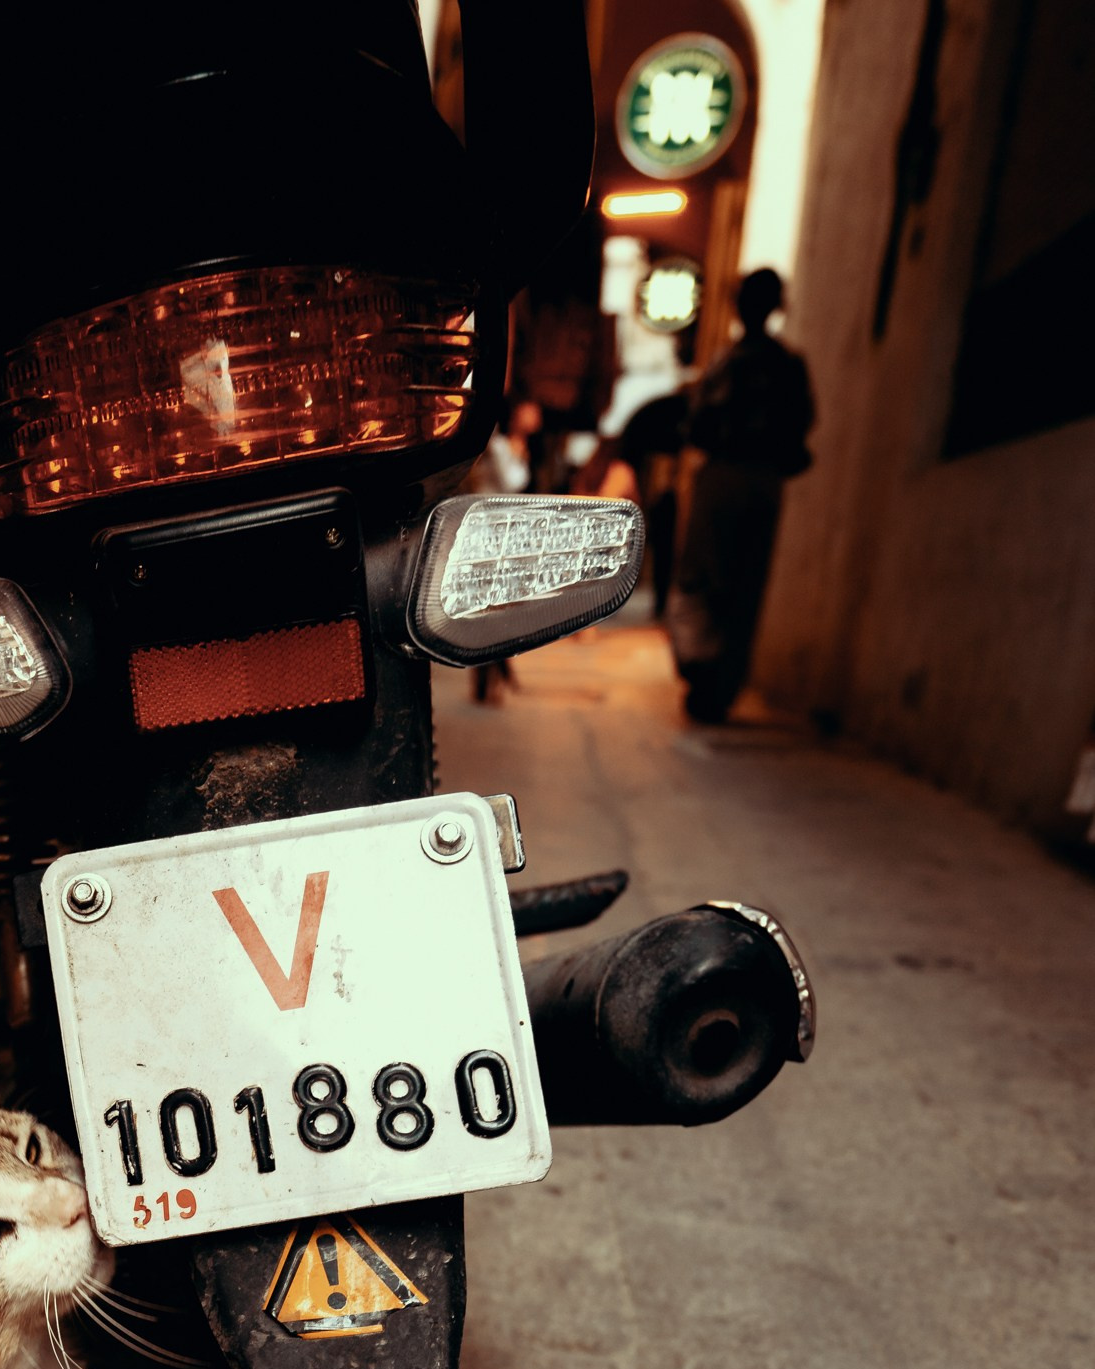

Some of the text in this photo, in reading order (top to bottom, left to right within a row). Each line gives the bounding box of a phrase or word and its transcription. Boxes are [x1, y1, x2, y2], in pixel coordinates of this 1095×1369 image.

[212, 871, 329, 1011] V
[104, 1049, 517, 1186] 101880
[133, 1189, 197, 1230] 519
